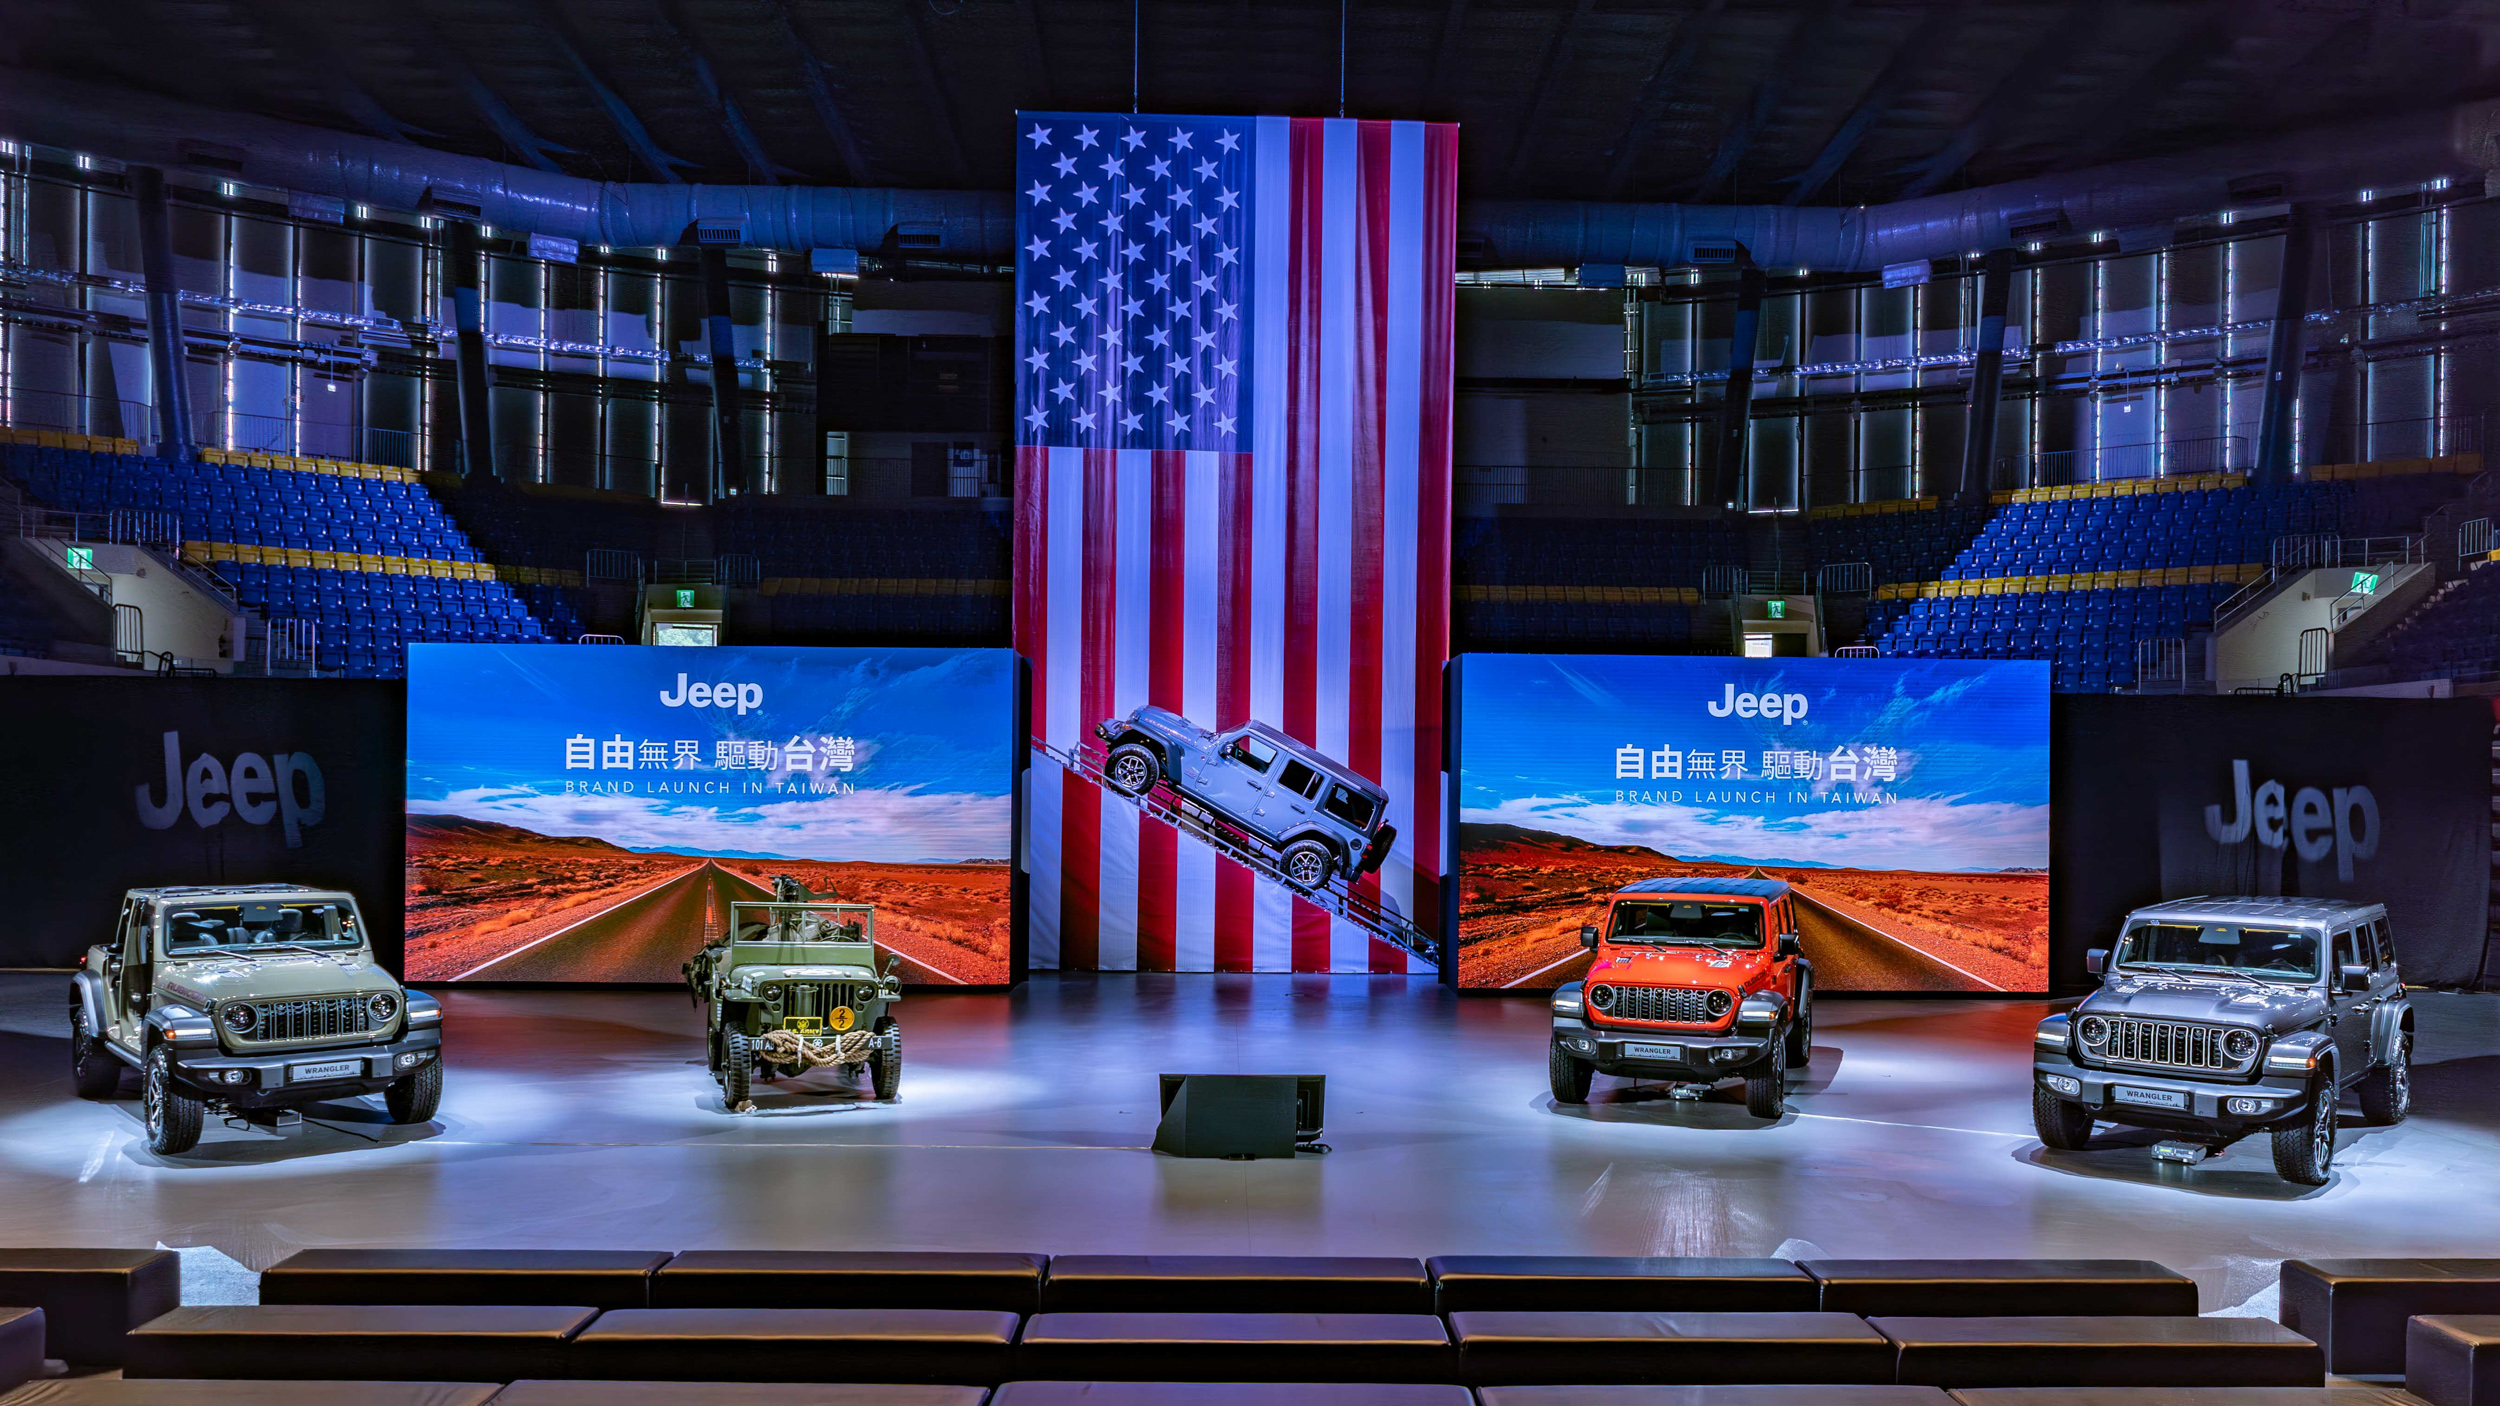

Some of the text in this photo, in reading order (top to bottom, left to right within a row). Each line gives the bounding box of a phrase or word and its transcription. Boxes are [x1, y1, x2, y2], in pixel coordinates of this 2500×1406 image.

[660, 673, 763, 715] Jeep
[1708, 683, 1808, 726] Jeep
[565, 733, 855, 772] 自由無界 驅動台灣
[1615, 743, 1898, 782] 自由無界 驅動台灣
[135, 731, 326, 849] Jeep
[565, 780, 854, 795] BRAND LAUNCH IN TAIWAN
[1615, 790, 1897, 804] BRAND LAUNCH IN TAIWAN
[2203, 759, 2381, 884] Jeep
[839, 1008, 846, 1016] 2
[838, 1020, 845, 1028] 2
[1633, 1046, 1672, 1055] WRANGLER
[304, 1064, 350, 1075] WRANGLER
[2126, 1090, 2173, 1102] WRANGLER
